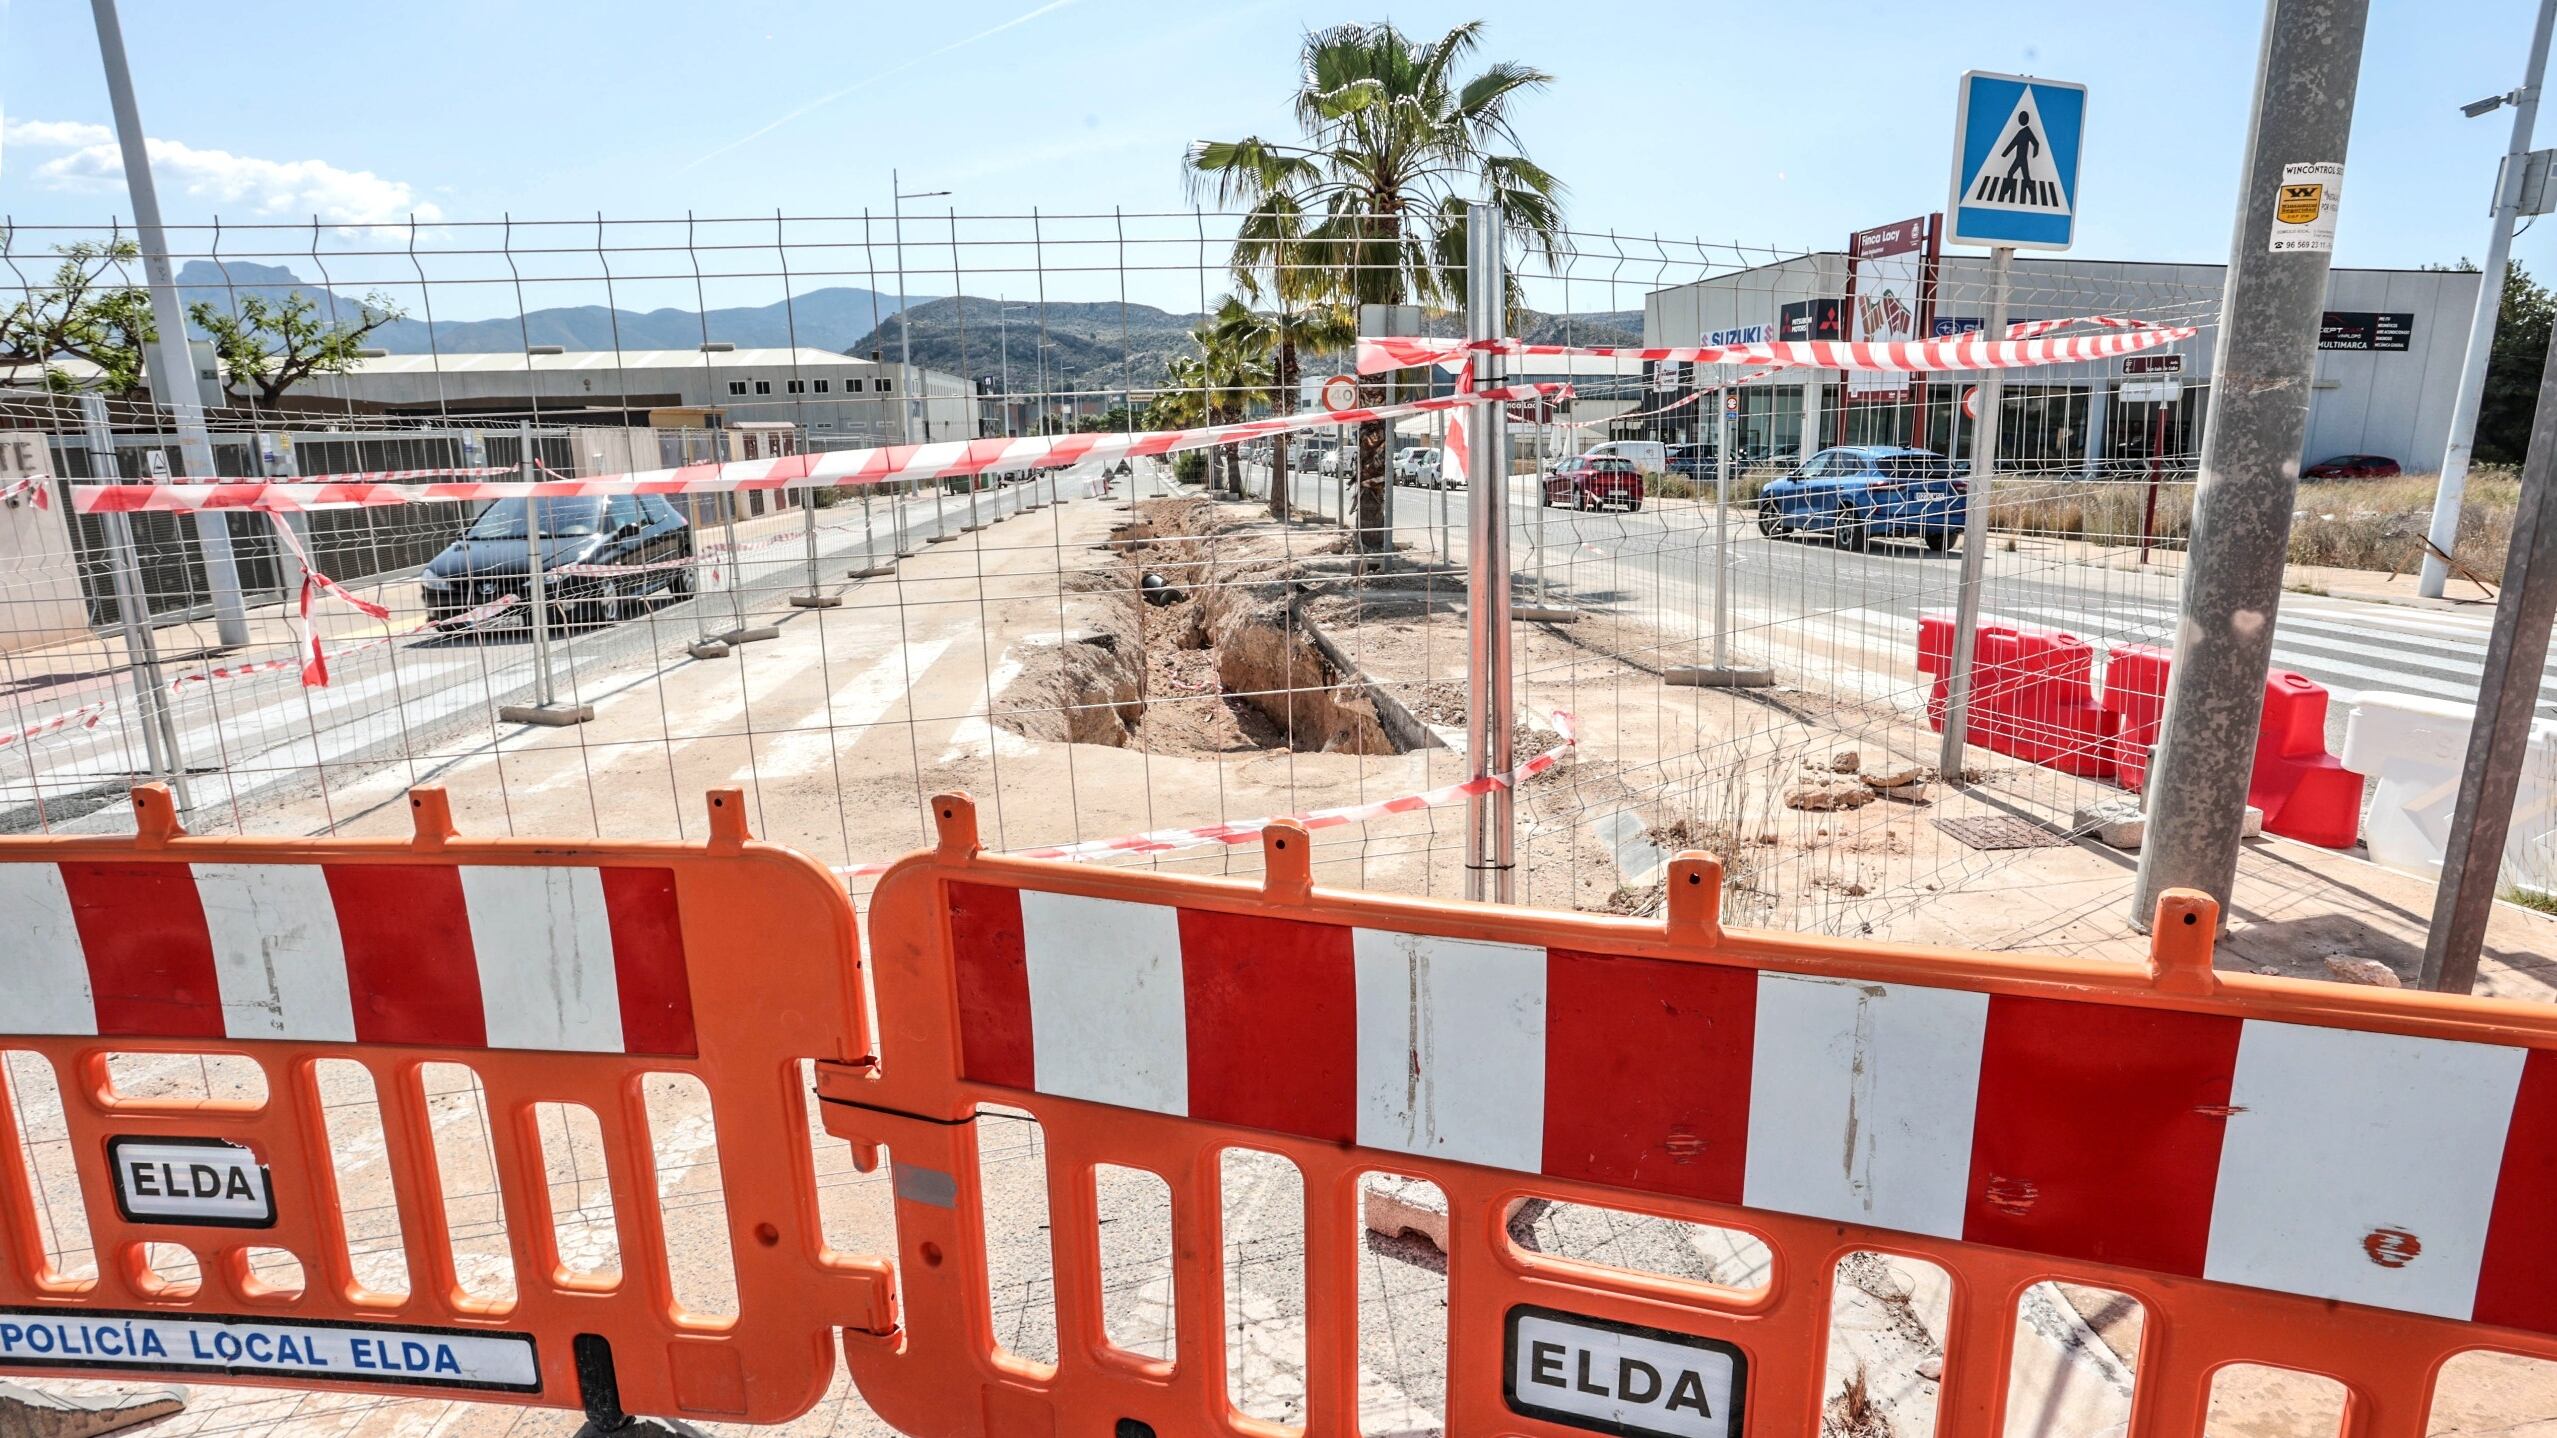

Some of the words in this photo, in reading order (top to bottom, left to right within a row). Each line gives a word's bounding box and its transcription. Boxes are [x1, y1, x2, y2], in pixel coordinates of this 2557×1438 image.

[2286, 165, 2336, 175] WINCONTROL
[1861, 234, 1881, 247] Finca
[1882, 230, 1901, 242] Lacy
[2286, 241, 2295, 249] 96
[2297, 241, 2310, 249] 569
[1711, 326, 1761, 346] SUZUKI
[2318, 341, 2368, 349] MULTIMARCA
[130, 1161, 256, 1201] ELDA
[0, 1320, 168, 1358] POLICÍA
[189, 1330, 329, 1366] LOCAL
[350, 1338, 462, 1374] ELDA
[1531, 1340, 1712, 1419] ELDA
